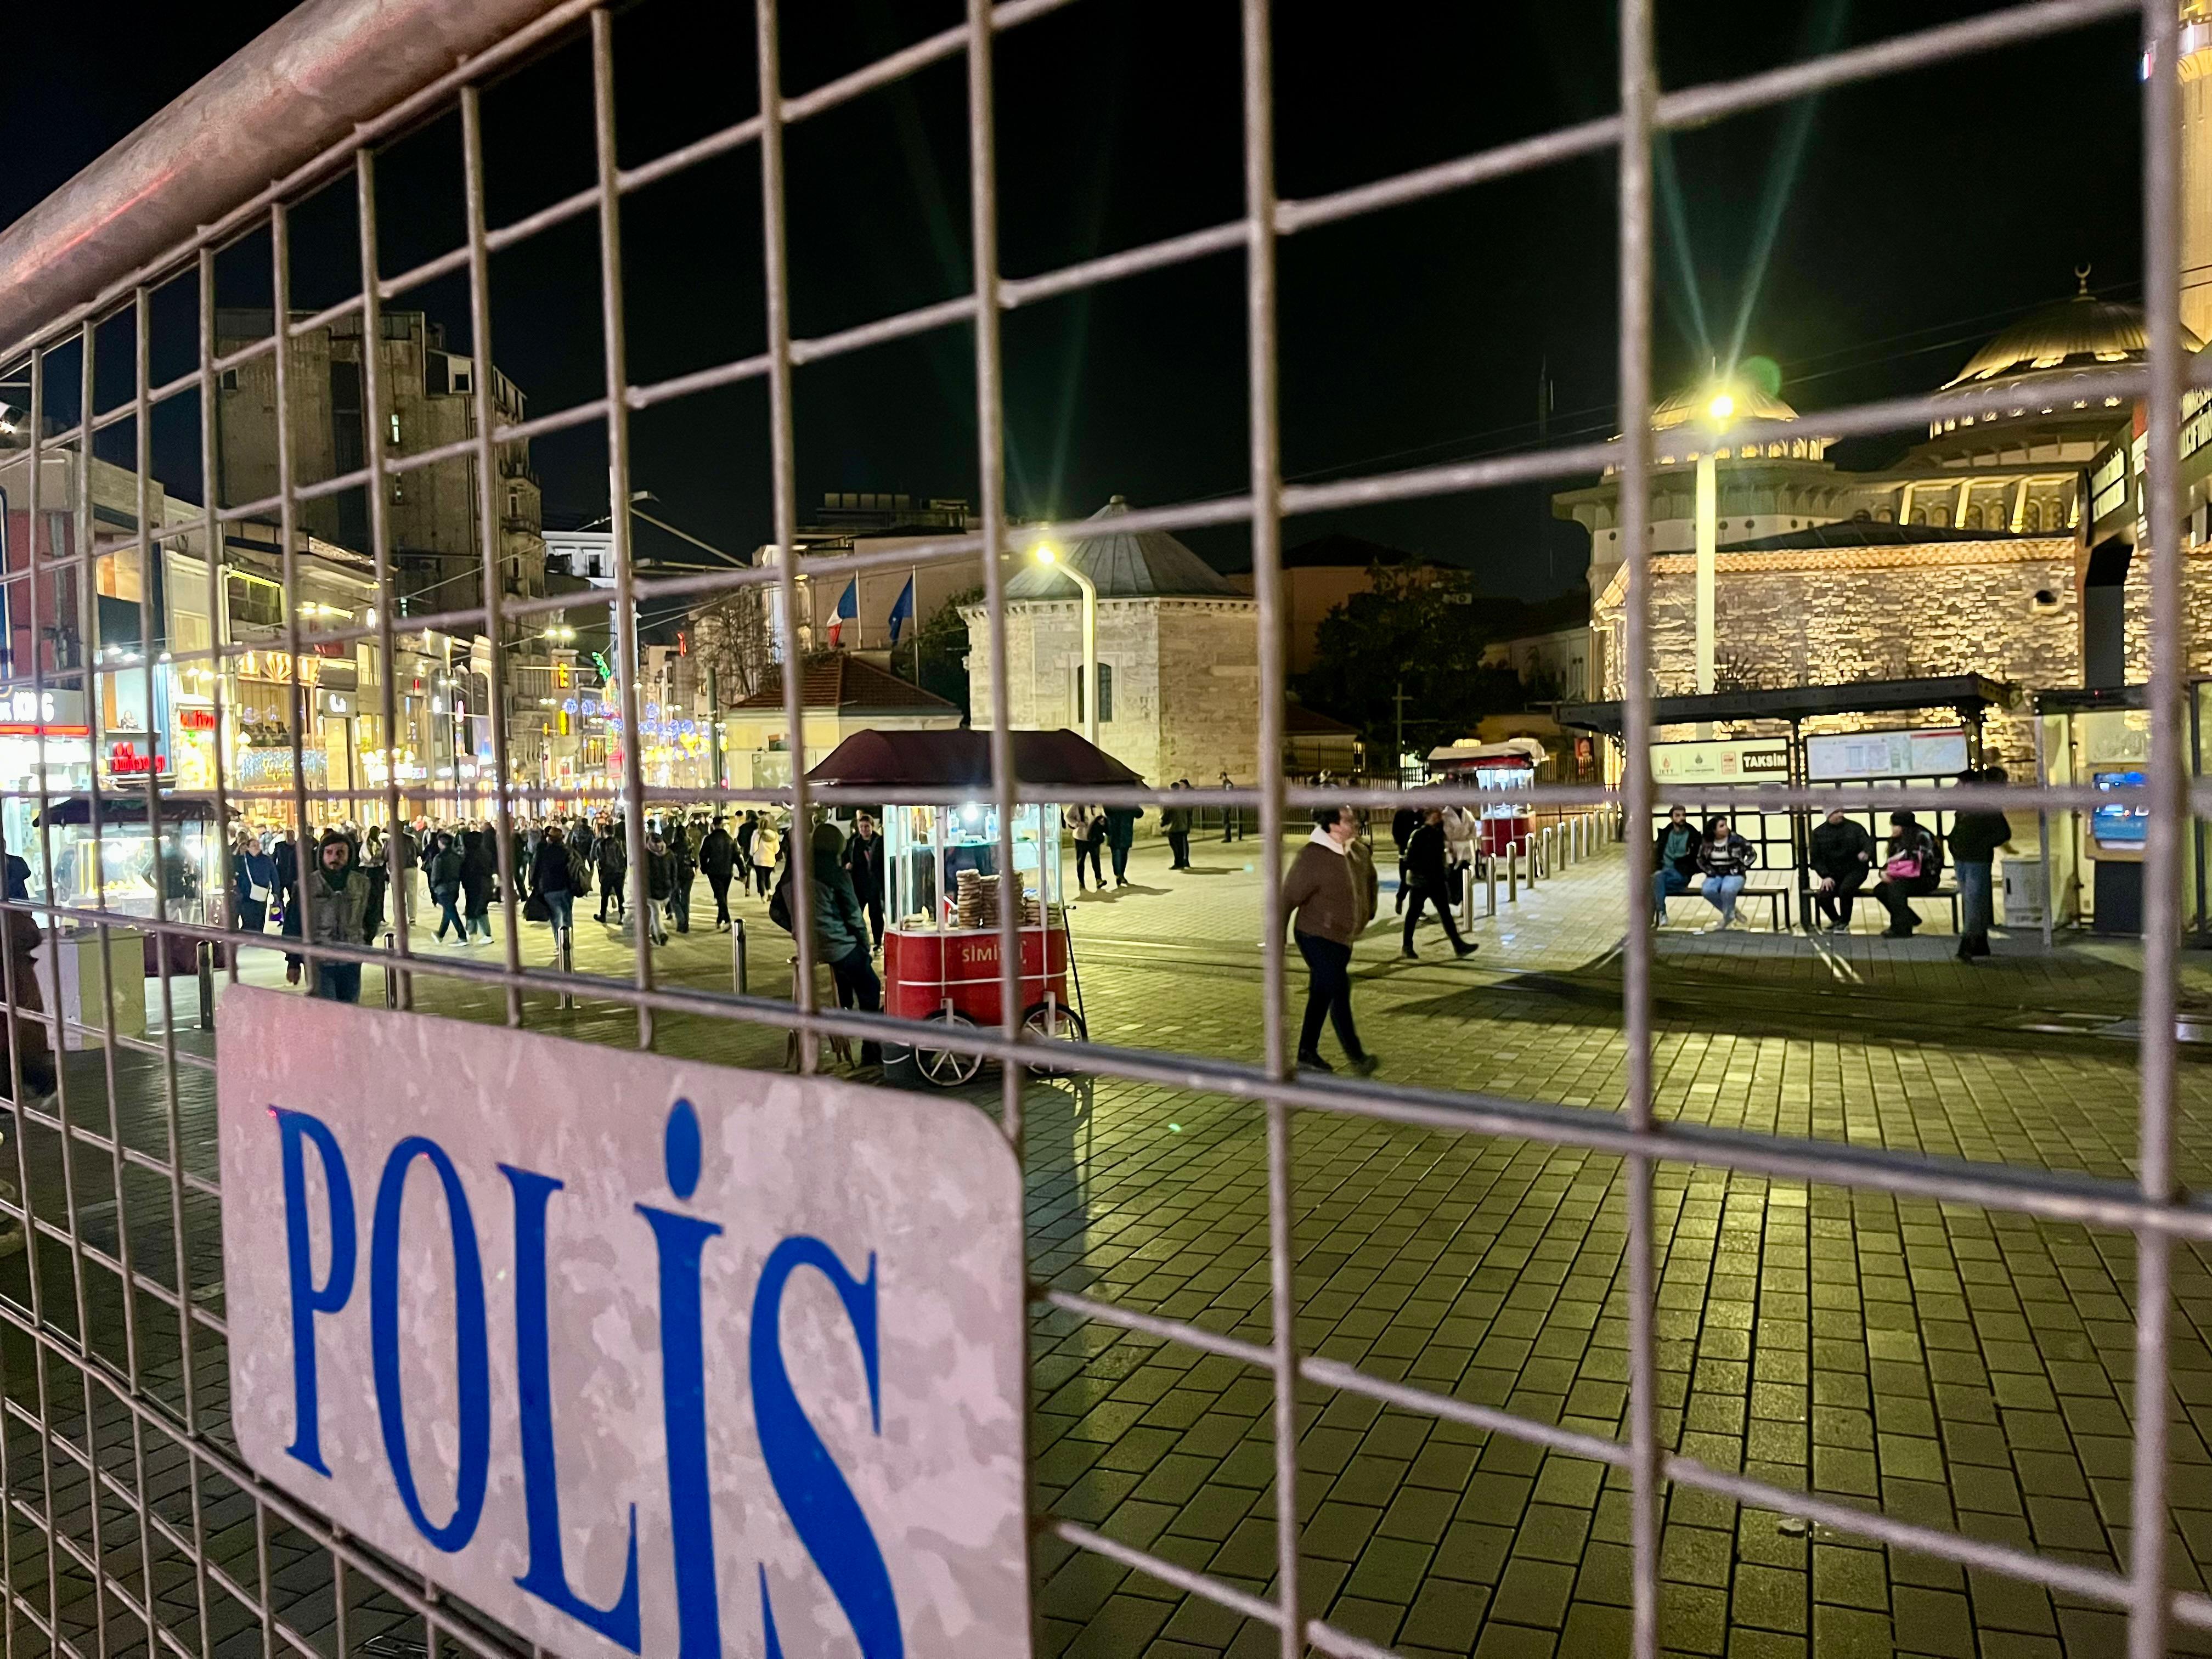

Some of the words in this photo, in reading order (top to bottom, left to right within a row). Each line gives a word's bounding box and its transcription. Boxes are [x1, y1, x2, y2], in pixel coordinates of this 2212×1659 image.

[1743, 753, 1787, 768] TAKSİM
[962, 944, 1023, 962] SİMİİ
[267, 1097, 904, 1659] POLİS
